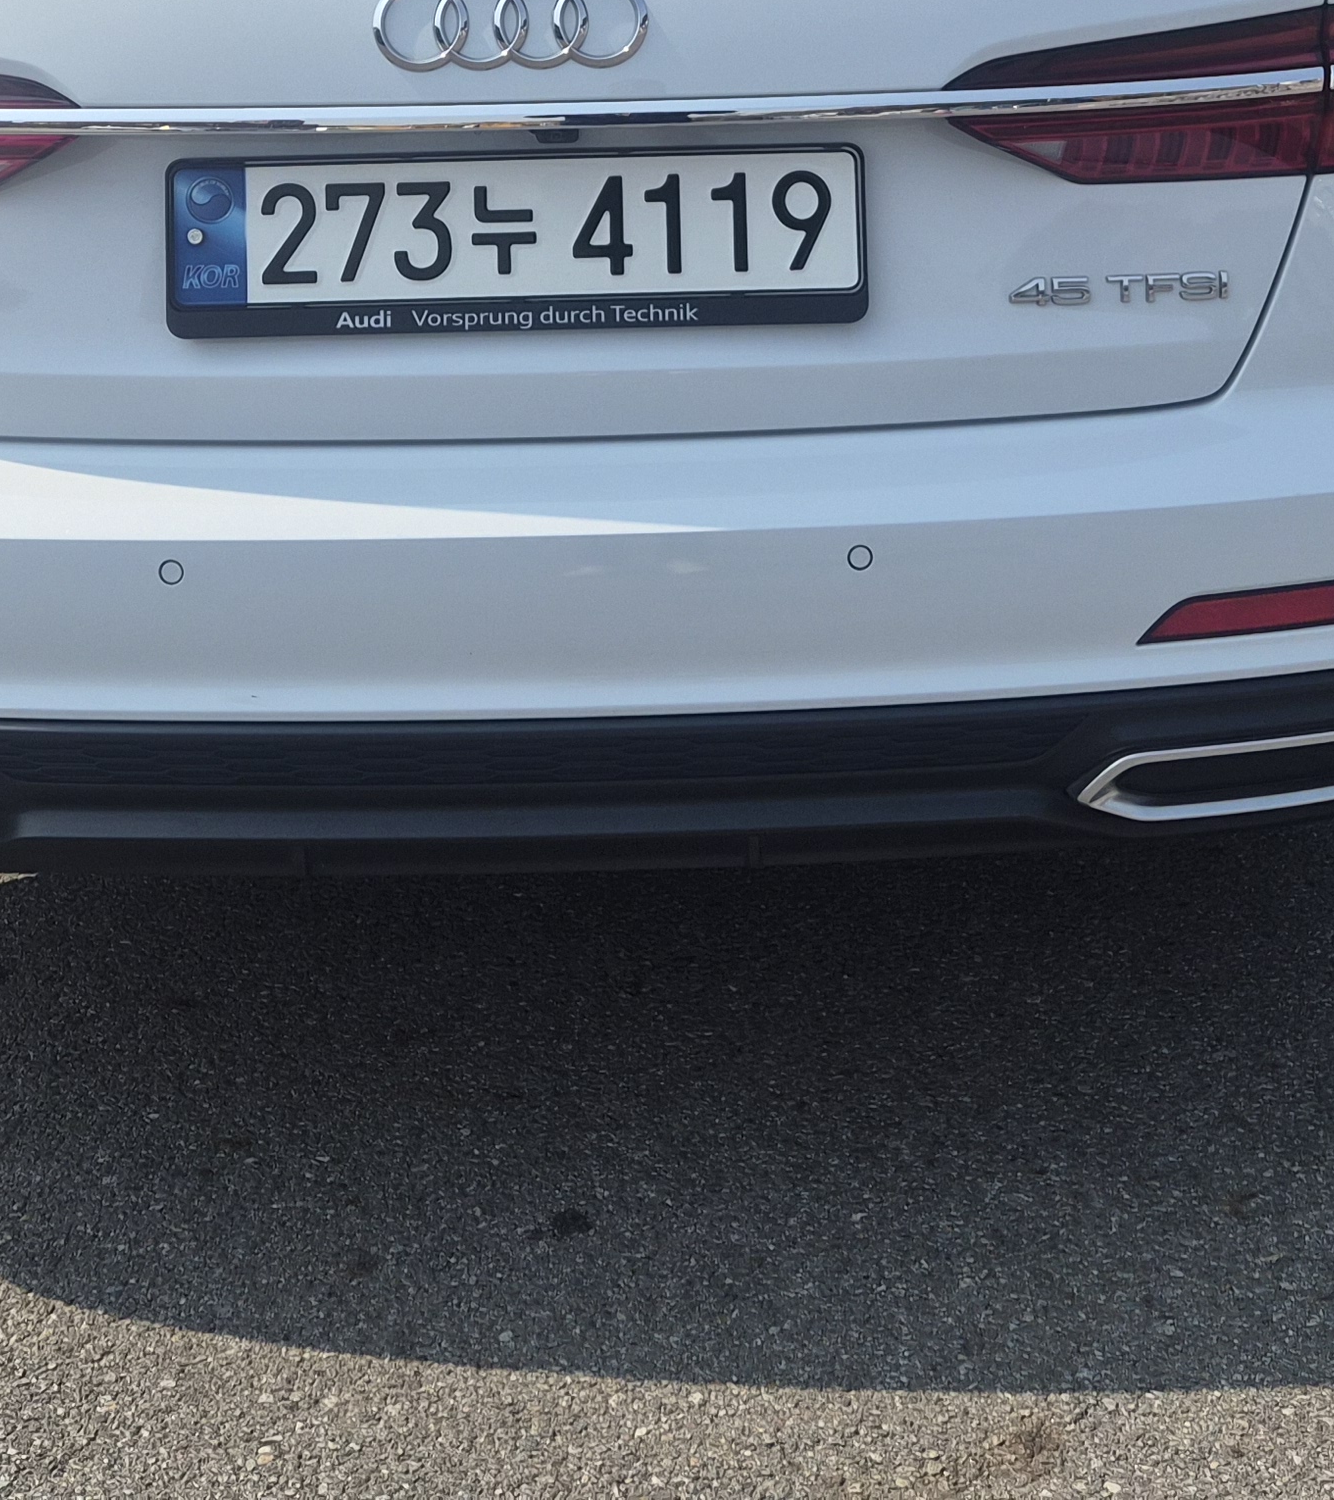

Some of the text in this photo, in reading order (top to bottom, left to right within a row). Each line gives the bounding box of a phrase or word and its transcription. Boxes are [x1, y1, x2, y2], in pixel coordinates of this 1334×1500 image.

[261, 170, 833, 286] 273누 4119
[182, 264, 240, 289] KOR
[1009, 270, 1229, 306] 45 TFSI
[336, 303, 699, 330] Audi Vorsprung durch Technik
